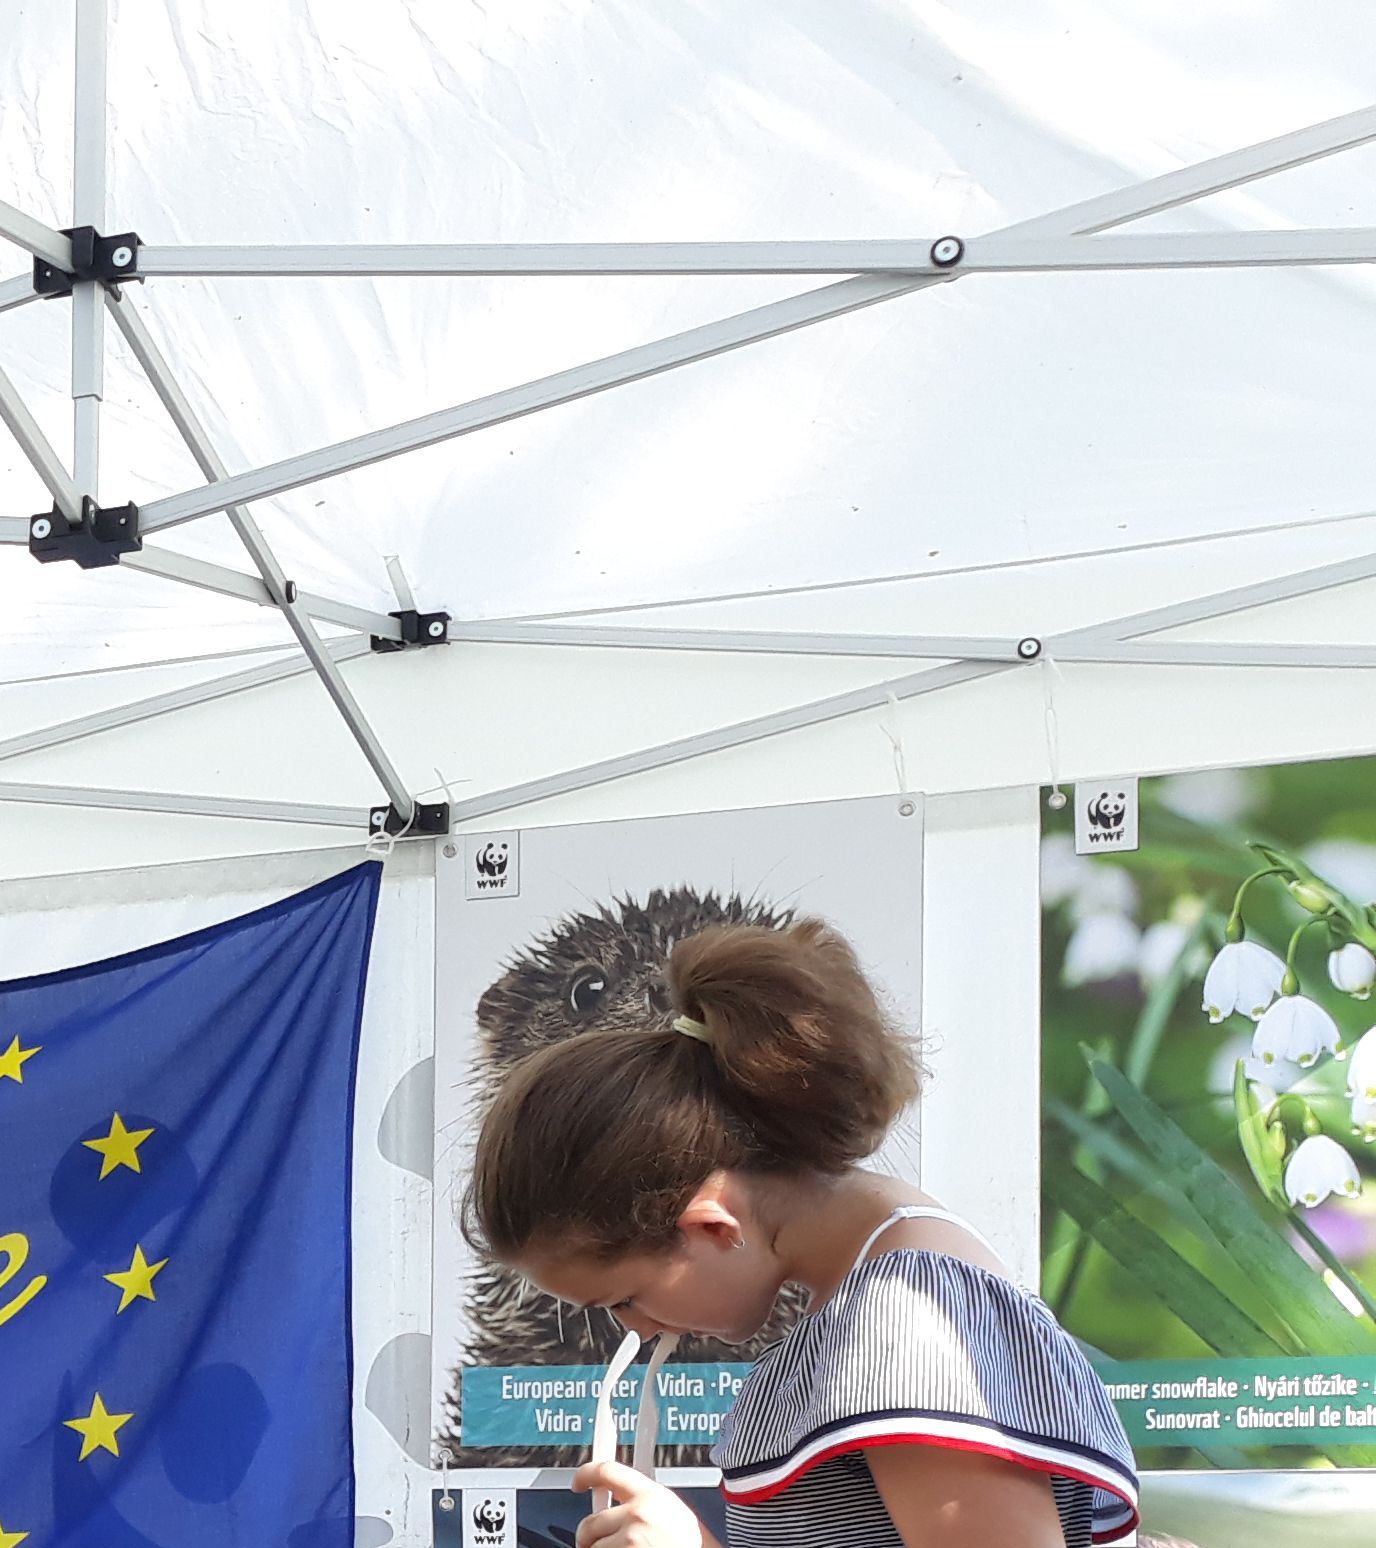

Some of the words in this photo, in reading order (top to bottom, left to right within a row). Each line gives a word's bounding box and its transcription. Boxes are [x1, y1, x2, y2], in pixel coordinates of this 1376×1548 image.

[1087, 829, 1125, 843] WWF
[476, 878, 508, 889] WWF
[501, 1375, 586, 1403] European
[590, 1377, 639, 1399] oter
[655, 1371, 704, 1397] Vidra
[717, 1370, 744, 1397] Pe
[1102, 1382, 1148, 1400] mmer
[1151, 1376, 1238, 1400] snowflake
[1254, 1374, 1299, 1401] Nyári
[534, 1407, 582, 1433] Vidra
[609, 1406, 639, 1432] idr
[666, 1406, 727, 1436] Evrop
[1145, 1408, 1221, 1430] Sunovrat
[1236, 1404, 1315, 1429] Ghiocelul
[1319, 1404, 1341, 1427] de
[473, 1534, 506, 1546] WWF
